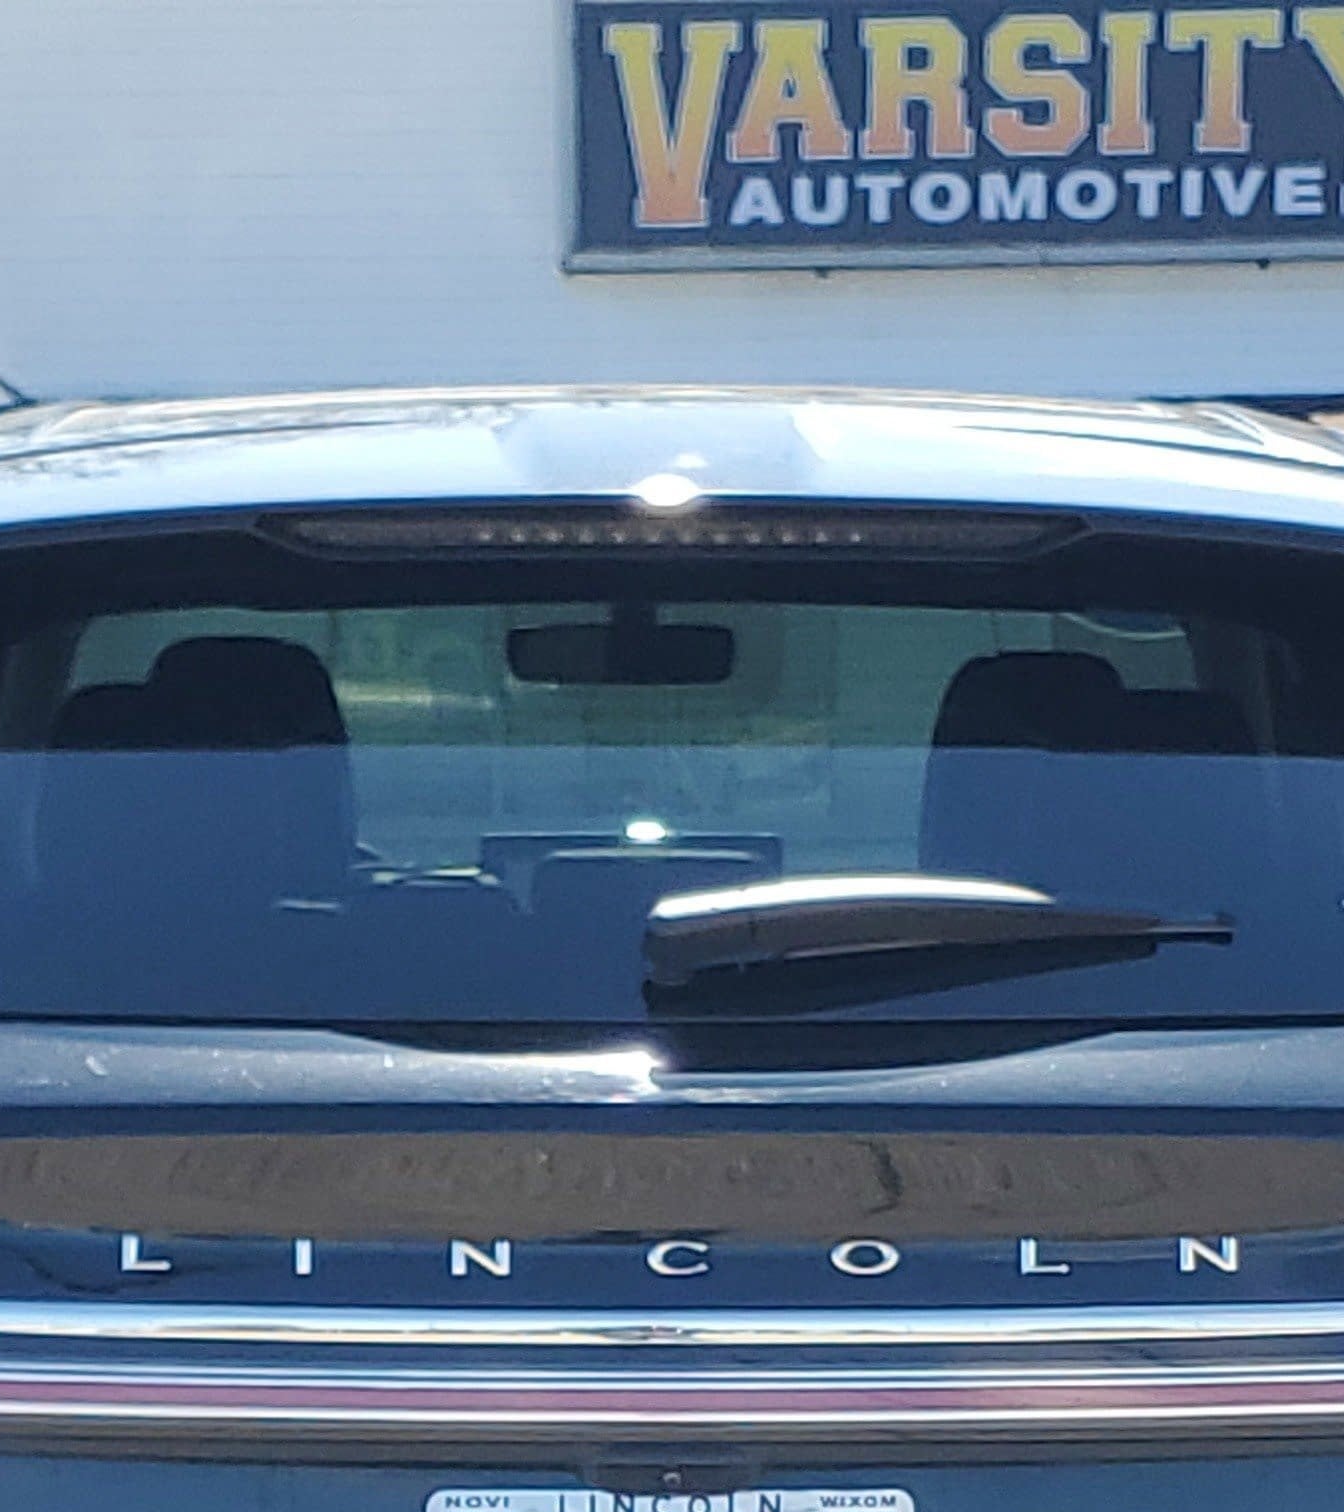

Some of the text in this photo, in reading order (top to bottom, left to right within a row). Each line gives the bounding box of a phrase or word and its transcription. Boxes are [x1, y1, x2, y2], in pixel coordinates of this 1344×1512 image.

[728, 164, 1325, 226] AUTOMOTIVE
[120, 1234, 1239, 1277] LINCOLN
[445, 1496, 510, 1508] NOVI
